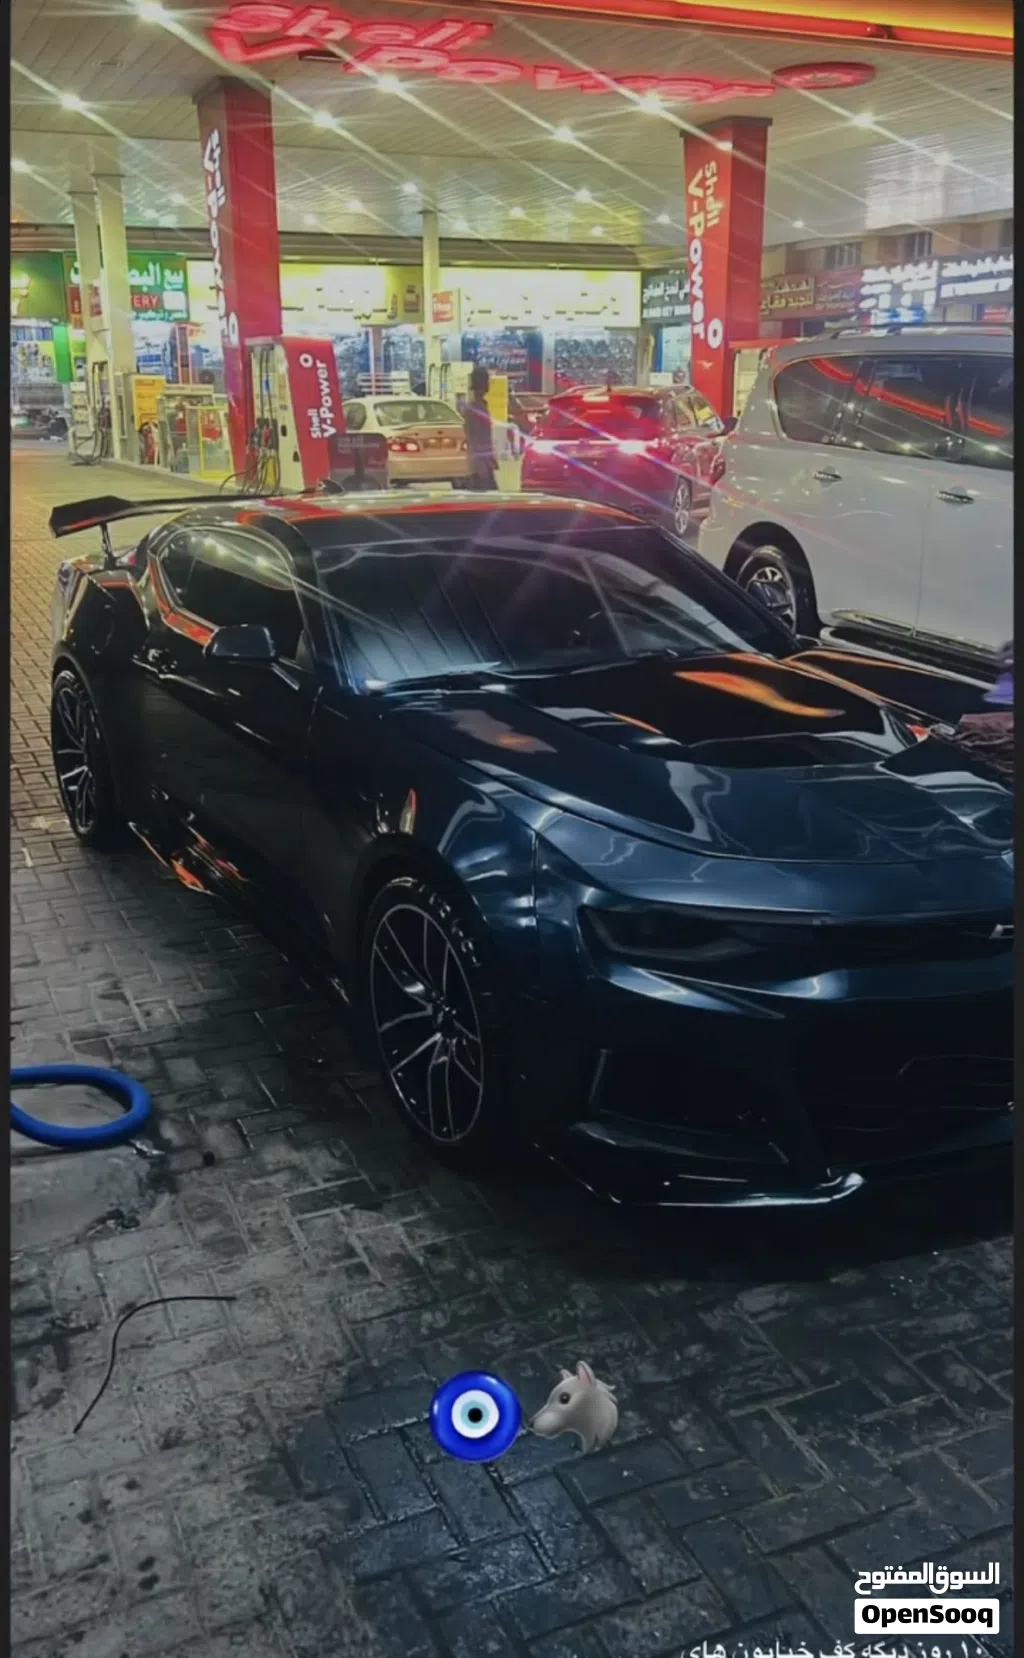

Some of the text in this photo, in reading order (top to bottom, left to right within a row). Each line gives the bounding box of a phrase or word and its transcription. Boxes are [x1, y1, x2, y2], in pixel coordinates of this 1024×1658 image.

[212, 3, 493, 50] Shell
[705, 161, 724, 228] Shell
[688, 169, 705, 340] V-Power
[307, 408, 322, 438] Shell
[316, 360, 337, 437] V-Power
